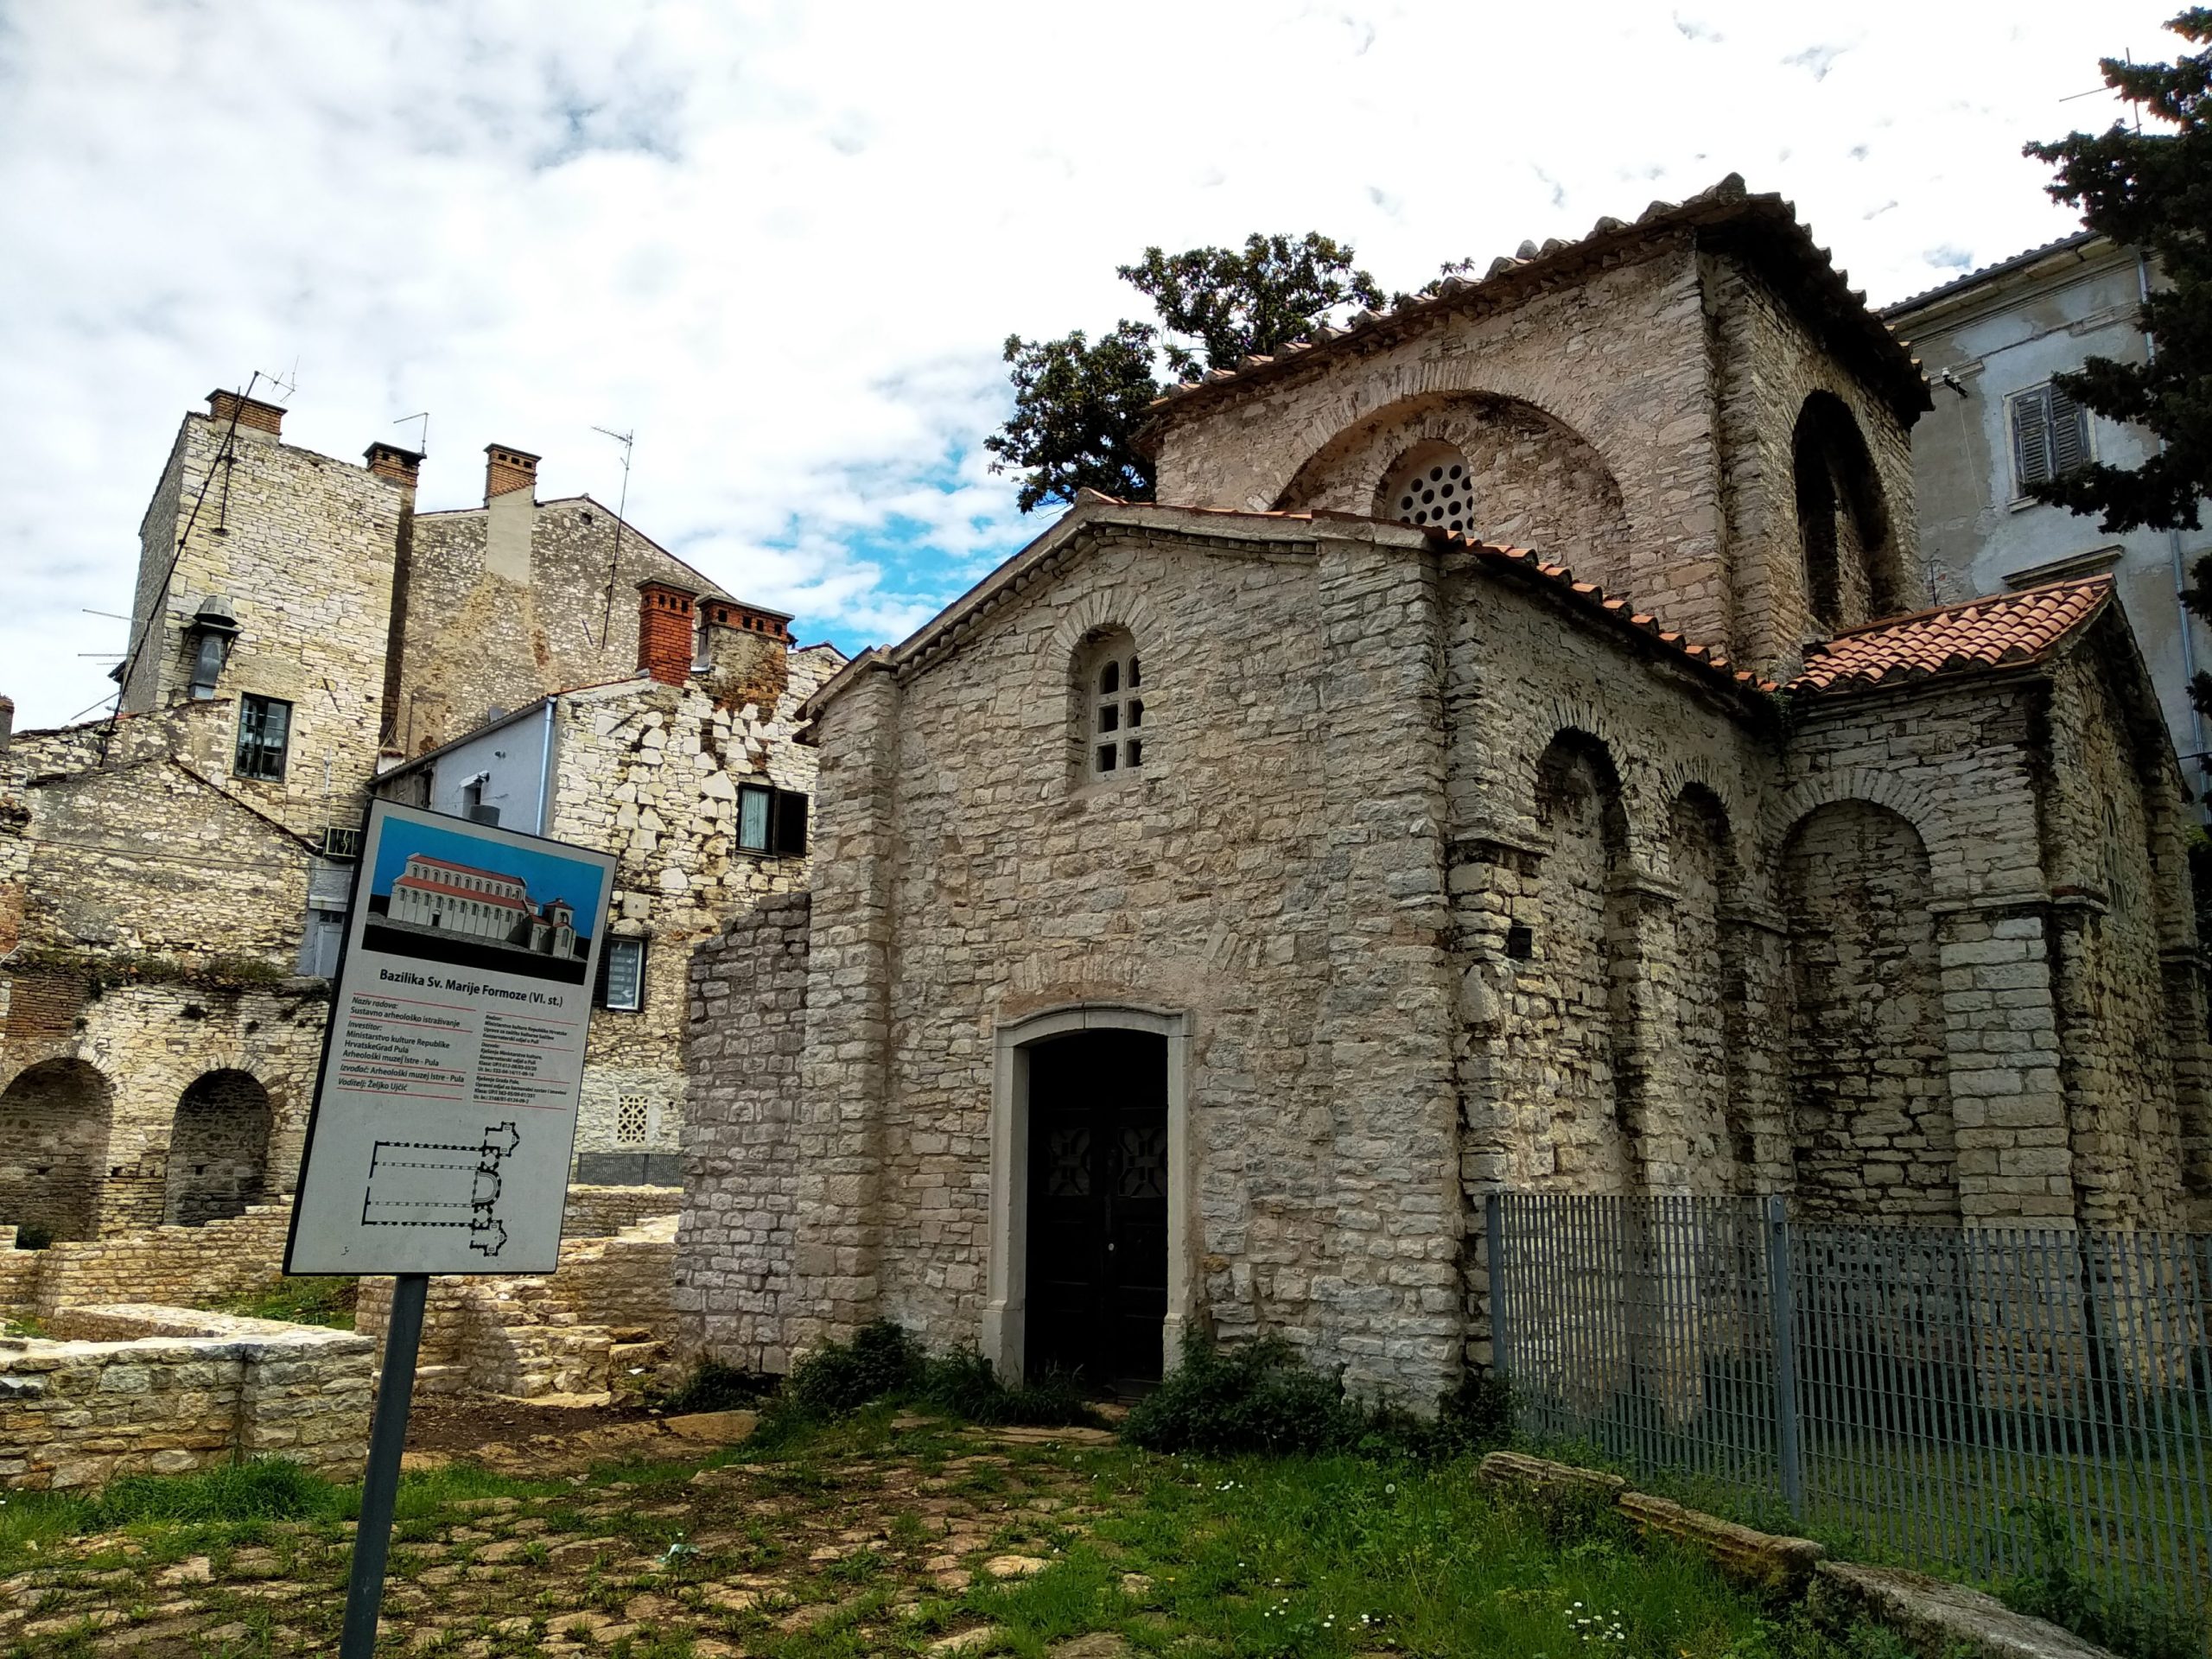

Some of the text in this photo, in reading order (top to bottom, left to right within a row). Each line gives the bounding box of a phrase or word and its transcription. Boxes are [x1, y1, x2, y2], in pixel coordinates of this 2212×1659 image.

[379, 969, 563, 1008] Bazilika Sv. Marije Formoze (VI. st.)
[352, 996, 398, 1009] Naziv radova:
[347, 1020, 383, 1031] Investitor:
[350, 1006, 461, 1028] Sustavno arheološko istraživanje
[346, 1030, 450, 1049] Ministarstvo kulture Republike
[394, 1045, 410, 1053] Pula
[342, 1050, 380, 1060] Arheološki
[382, 1055, 404, 1065] muzej
[424, 1058, 440, 1067] Pula
[370, 1066, 408, 1077] Arheološki
[409, 1071, 429, 1080] muzej
[449, 1074, 465, 1083] Pula
[338, 1077, 408, 1092] Voditelj: Željko Ujčić
